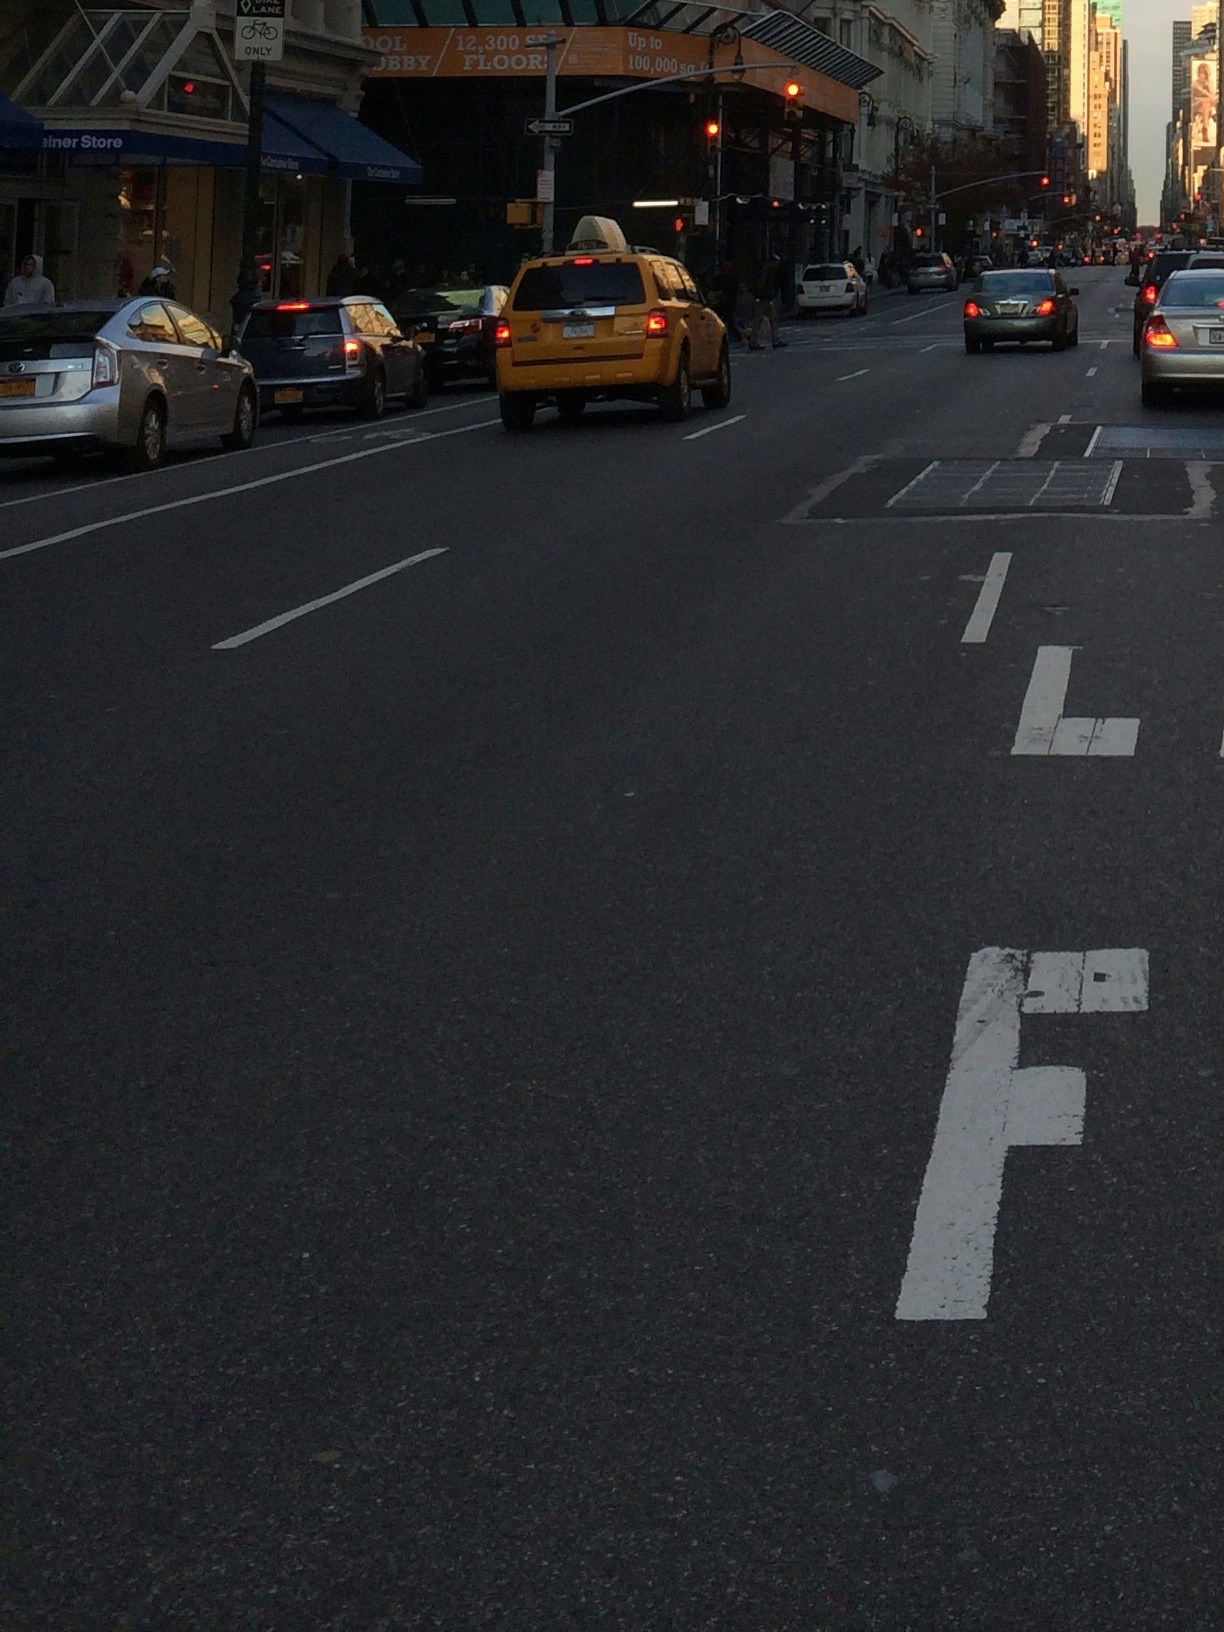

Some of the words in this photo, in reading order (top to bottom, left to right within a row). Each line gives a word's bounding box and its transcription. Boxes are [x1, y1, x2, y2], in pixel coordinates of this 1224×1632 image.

[252, 6, 282, 14] LANE
[456, 34, 520, 54] 12,300
[627, 32, 647, 54] Up
[650, 38, 663, 50] to
[245, 47, 272, 56] ONLY
[463, 54, 548, 70] FLOOR
[627, 55, 678, 74] 100,000
[81, 135, 123, 149] Store
